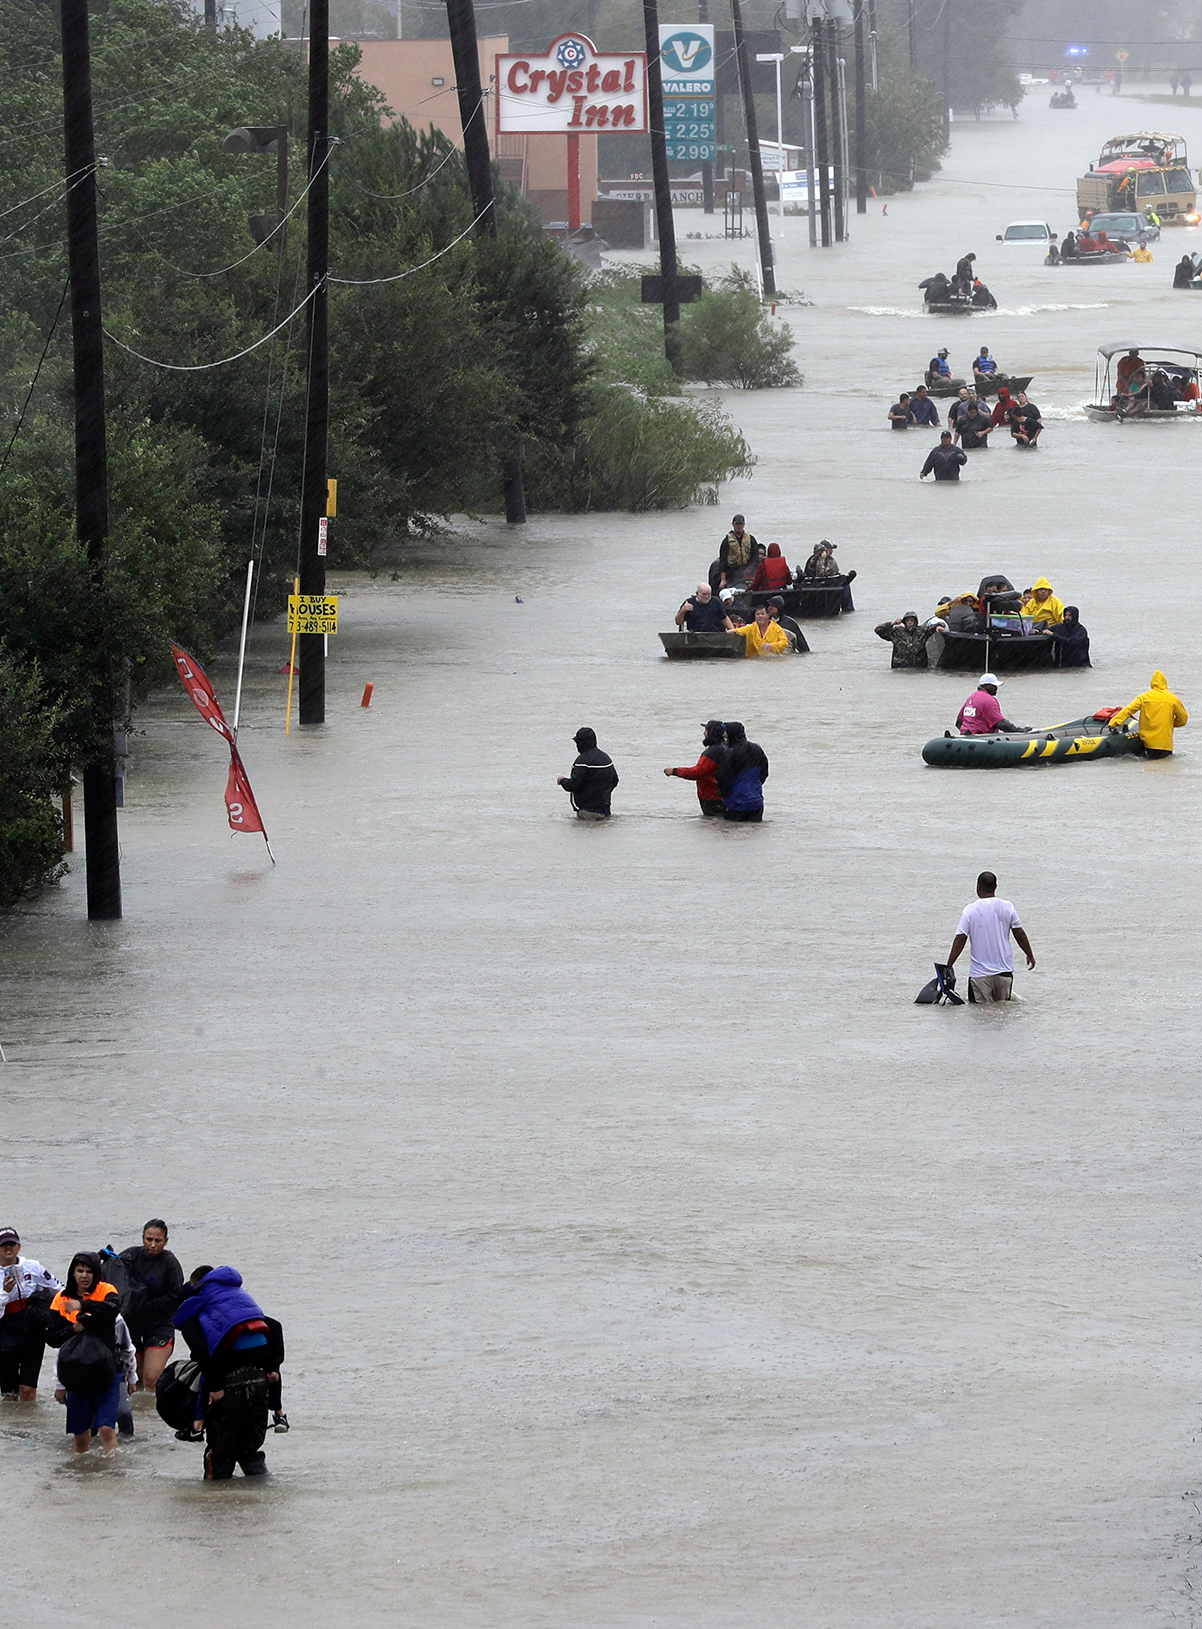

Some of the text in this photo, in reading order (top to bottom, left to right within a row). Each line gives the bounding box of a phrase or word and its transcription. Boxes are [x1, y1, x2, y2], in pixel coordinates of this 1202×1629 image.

[508, 60, 635, 103] Crystal
[662, 83, 711, 92] VALERO
[567, 96, 635, 127] Inn
[671, 192, 703, 201] ANCH
[290, 604, 336, 615] HOUSES
[289, 621, 336, 632] 73-489-5114
